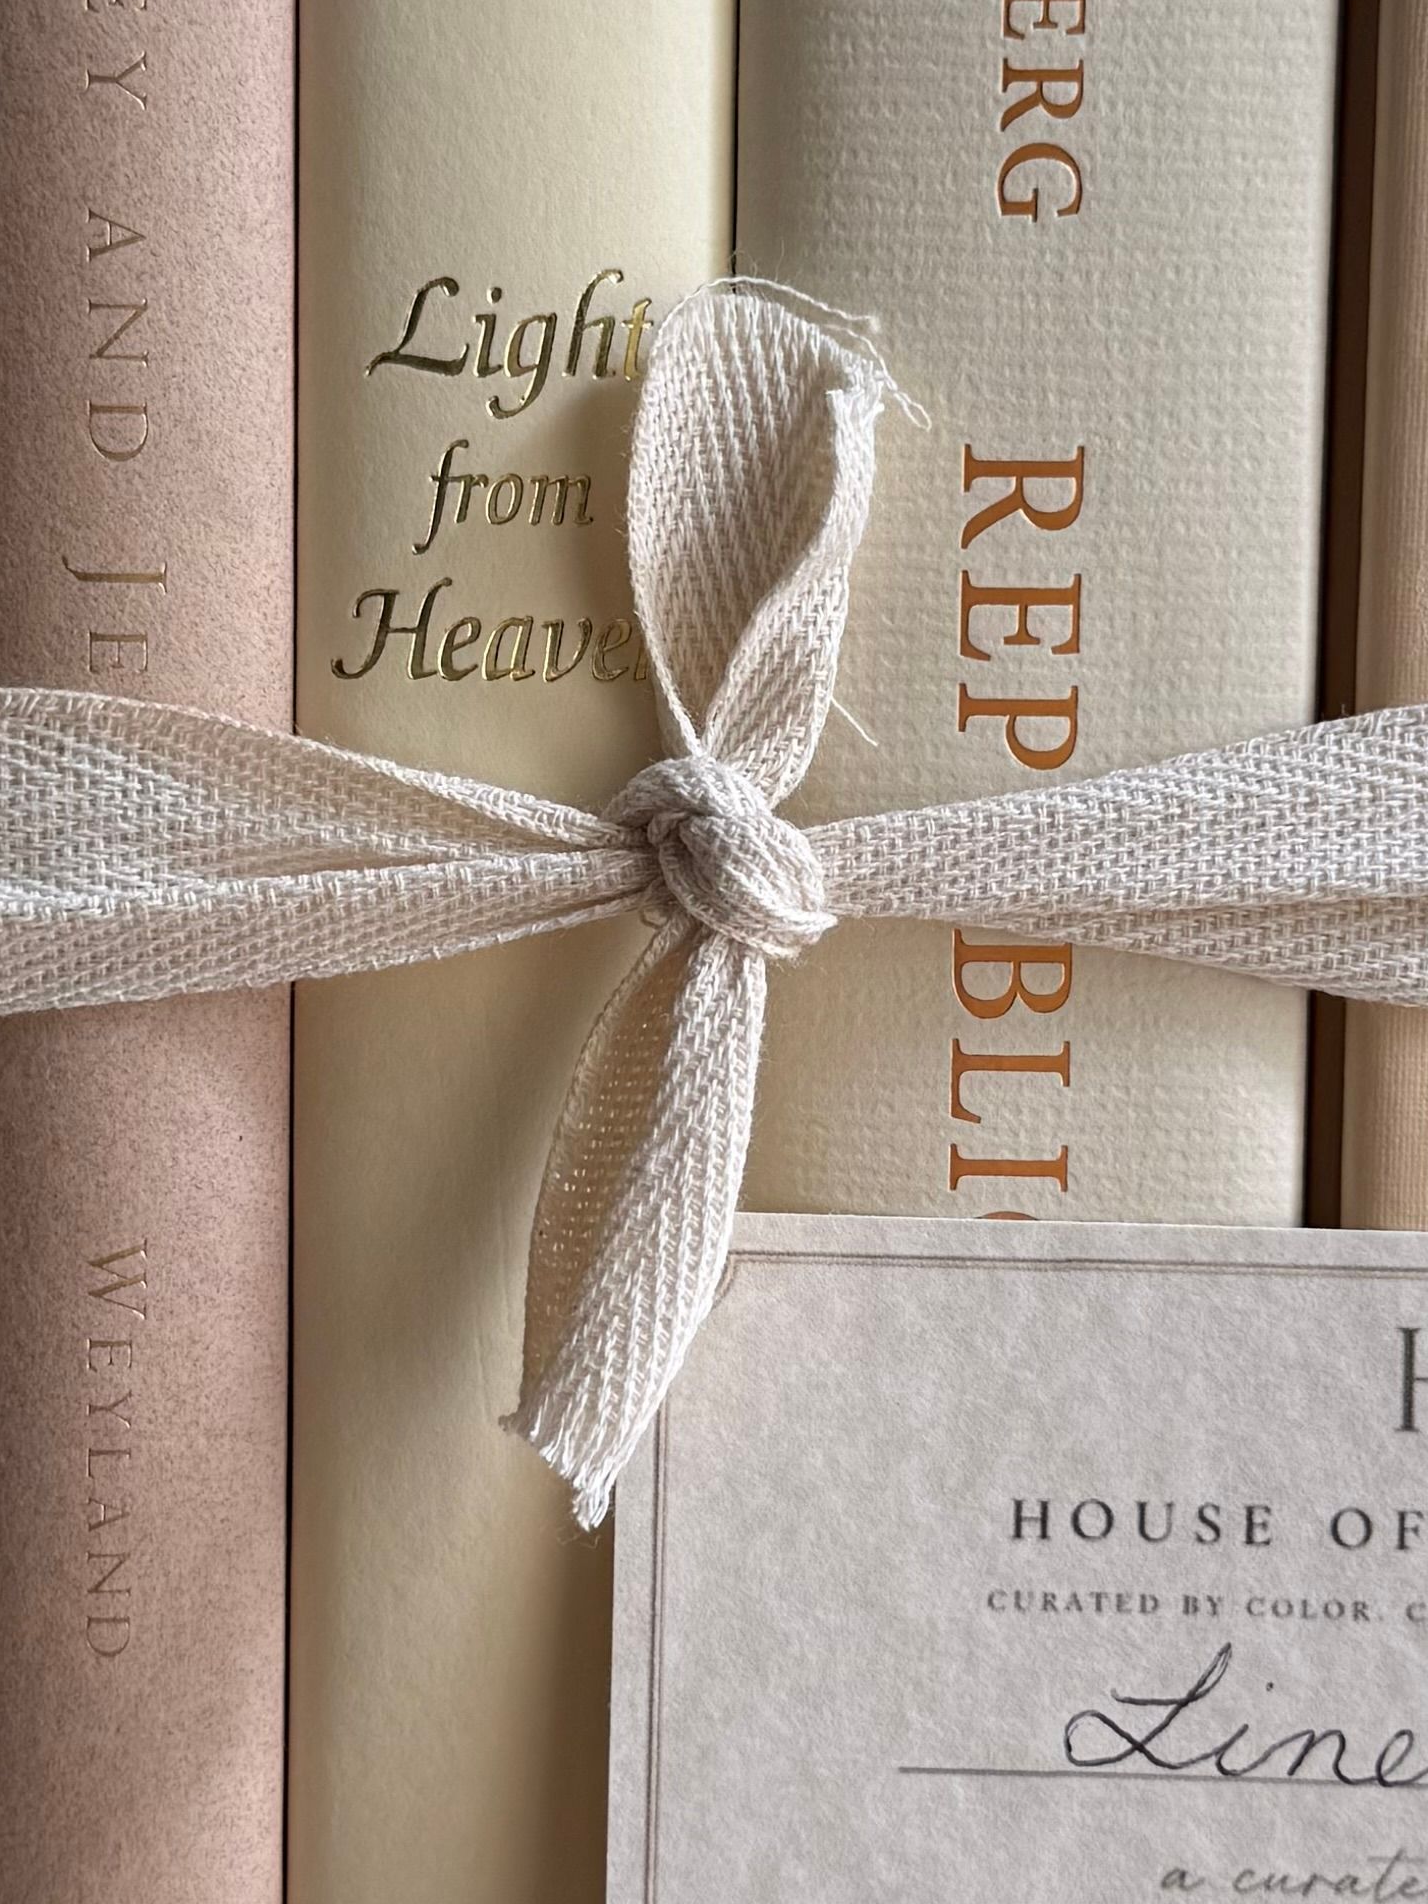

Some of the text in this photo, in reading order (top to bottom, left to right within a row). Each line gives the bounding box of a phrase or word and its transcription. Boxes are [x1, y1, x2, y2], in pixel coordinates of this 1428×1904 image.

[86, 210, 149, 464] AND
[365, 268, 655, 420] Light
[412, 438, 594, 555] from
[61, 555, 168, 674] JE
[948, 443, 1085, 1221] REPBLI
[85, 1238, 149, 1660] WEYLAND
[1010, 1498, 1272, 1547] HOUSE
[1329, 1507, 1425, 1551] OF
[987, 1590, 1160, 1614] CURATED
[1181, 1594, 1223, 1617] BY
[1160, 1862, 1202, 1896] a
